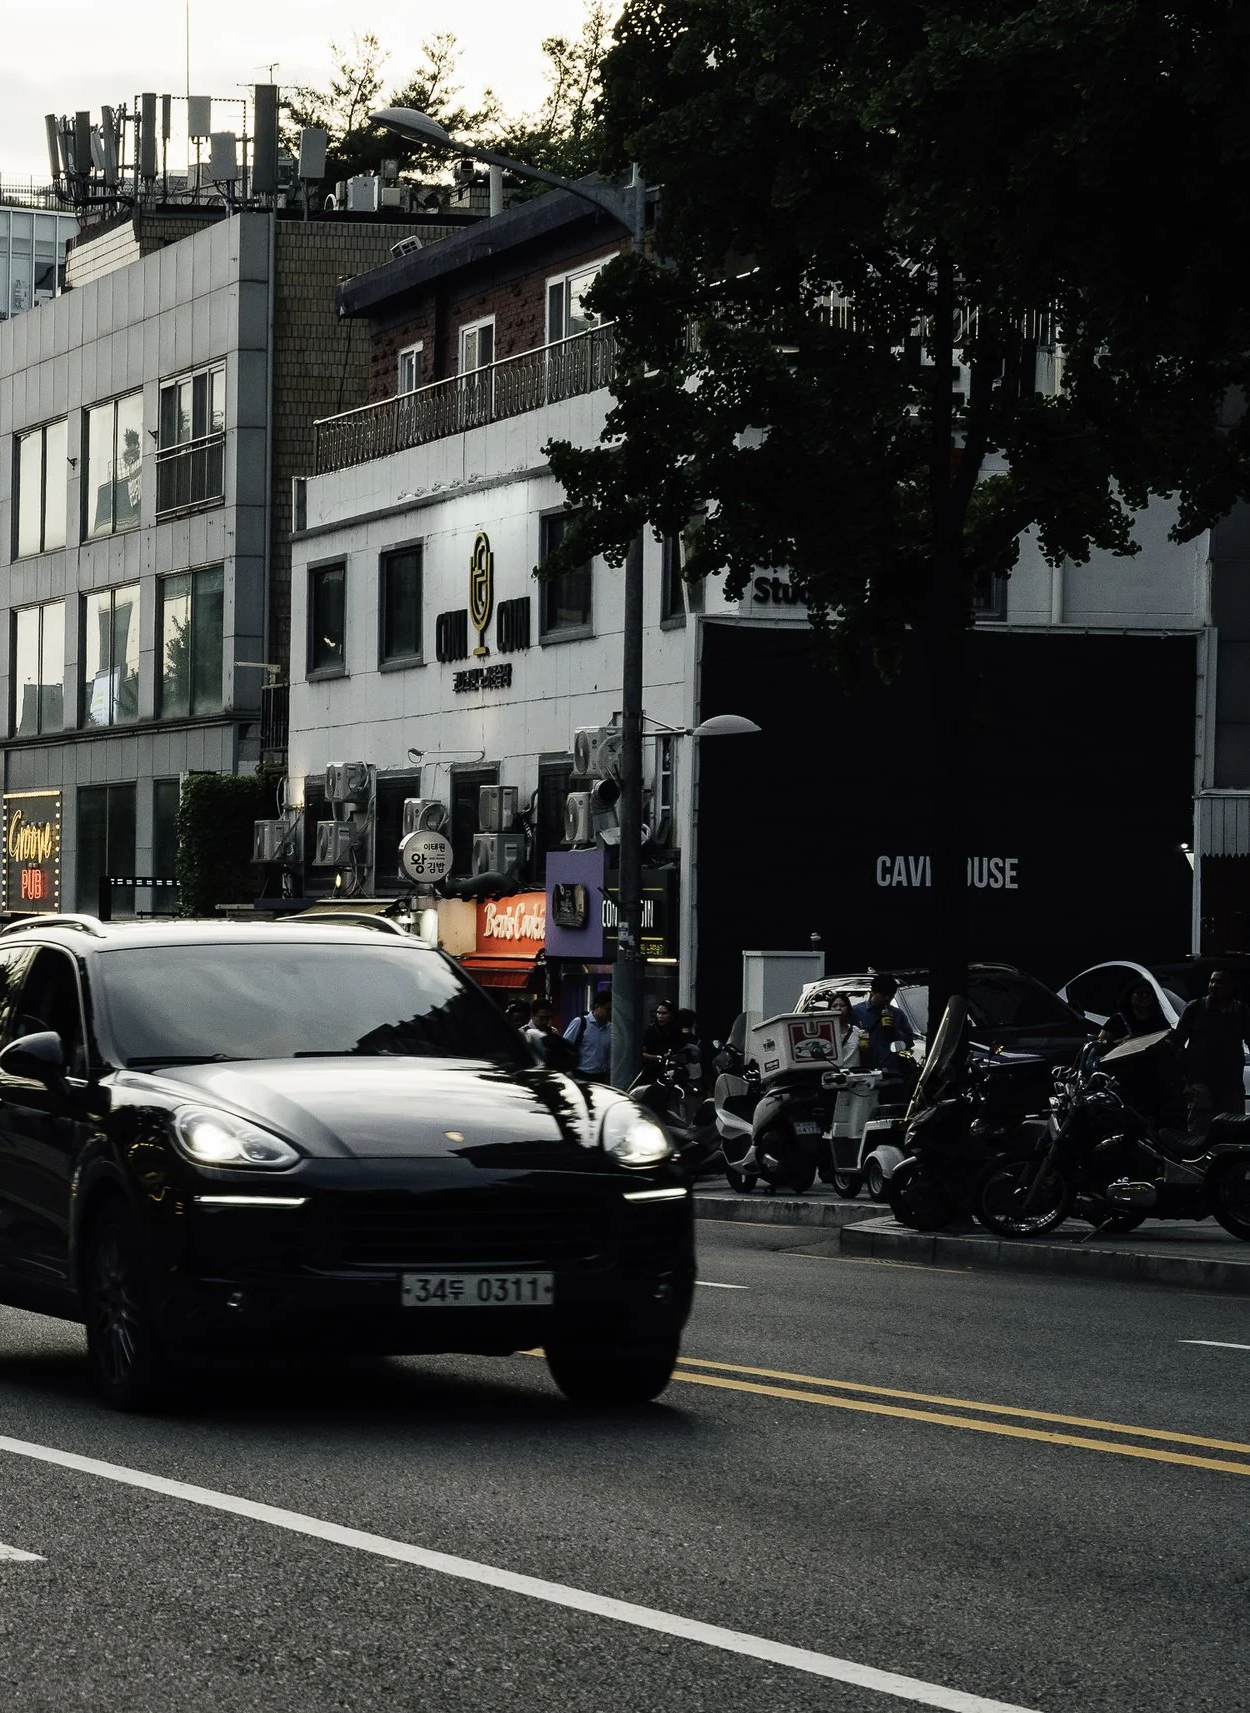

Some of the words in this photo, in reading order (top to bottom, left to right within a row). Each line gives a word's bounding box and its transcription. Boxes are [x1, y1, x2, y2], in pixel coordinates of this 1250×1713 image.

[423, 842, 446, 853] 이태원
[410, 853, 427, 874] 왕
[427, 862, 446, 874] 김밥
[876, 855, 932, 887] CAVI
[966, 856, 1019, 889] USE
[21, 869, 42, 900] PUB
[483, 903, 514, 940] Ben's
[477, 1277, 539, 1302] 0311
